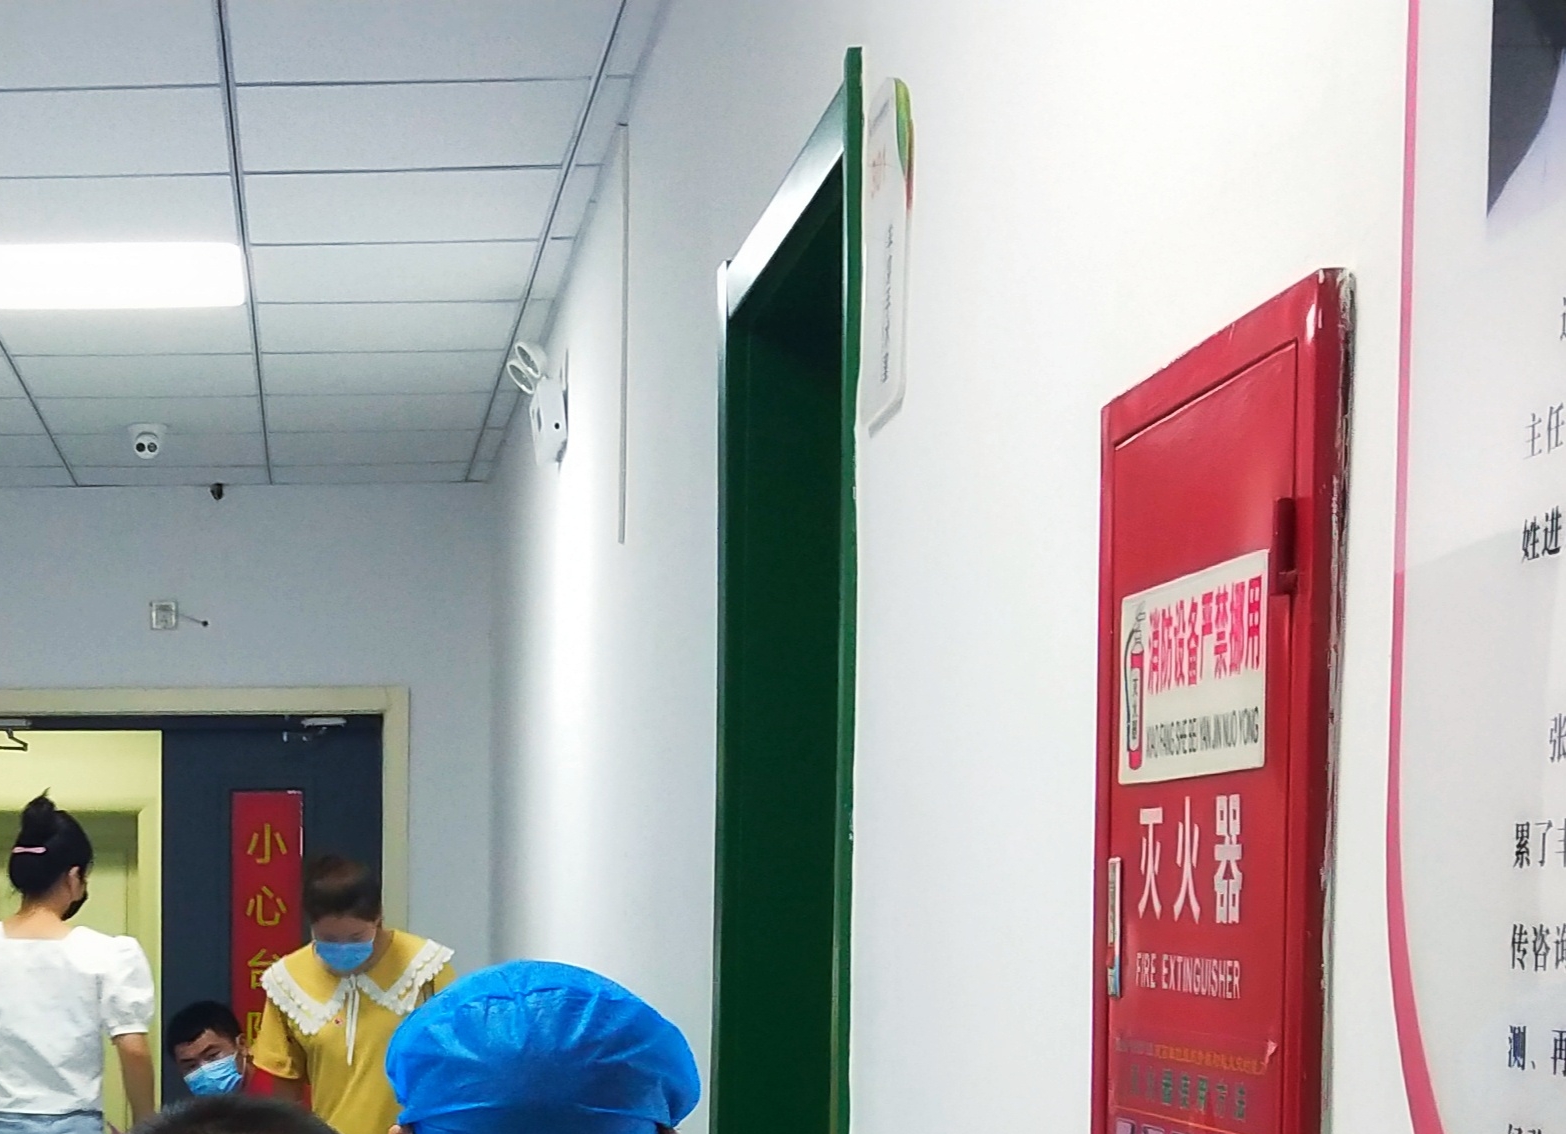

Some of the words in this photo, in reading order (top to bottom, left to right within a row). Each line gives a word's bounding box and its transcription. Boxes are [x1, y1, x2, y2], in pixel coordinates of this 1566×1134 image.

[1523, 402, 1566, 460] 主任
[1521, 505, 1562, 565] 姓进
[1137, 793, 1243, 924] 灭火器
[1136, 951, 1156, 989] FIRE
[1161, 953, 1241, 1000] EXTINGUISHER
